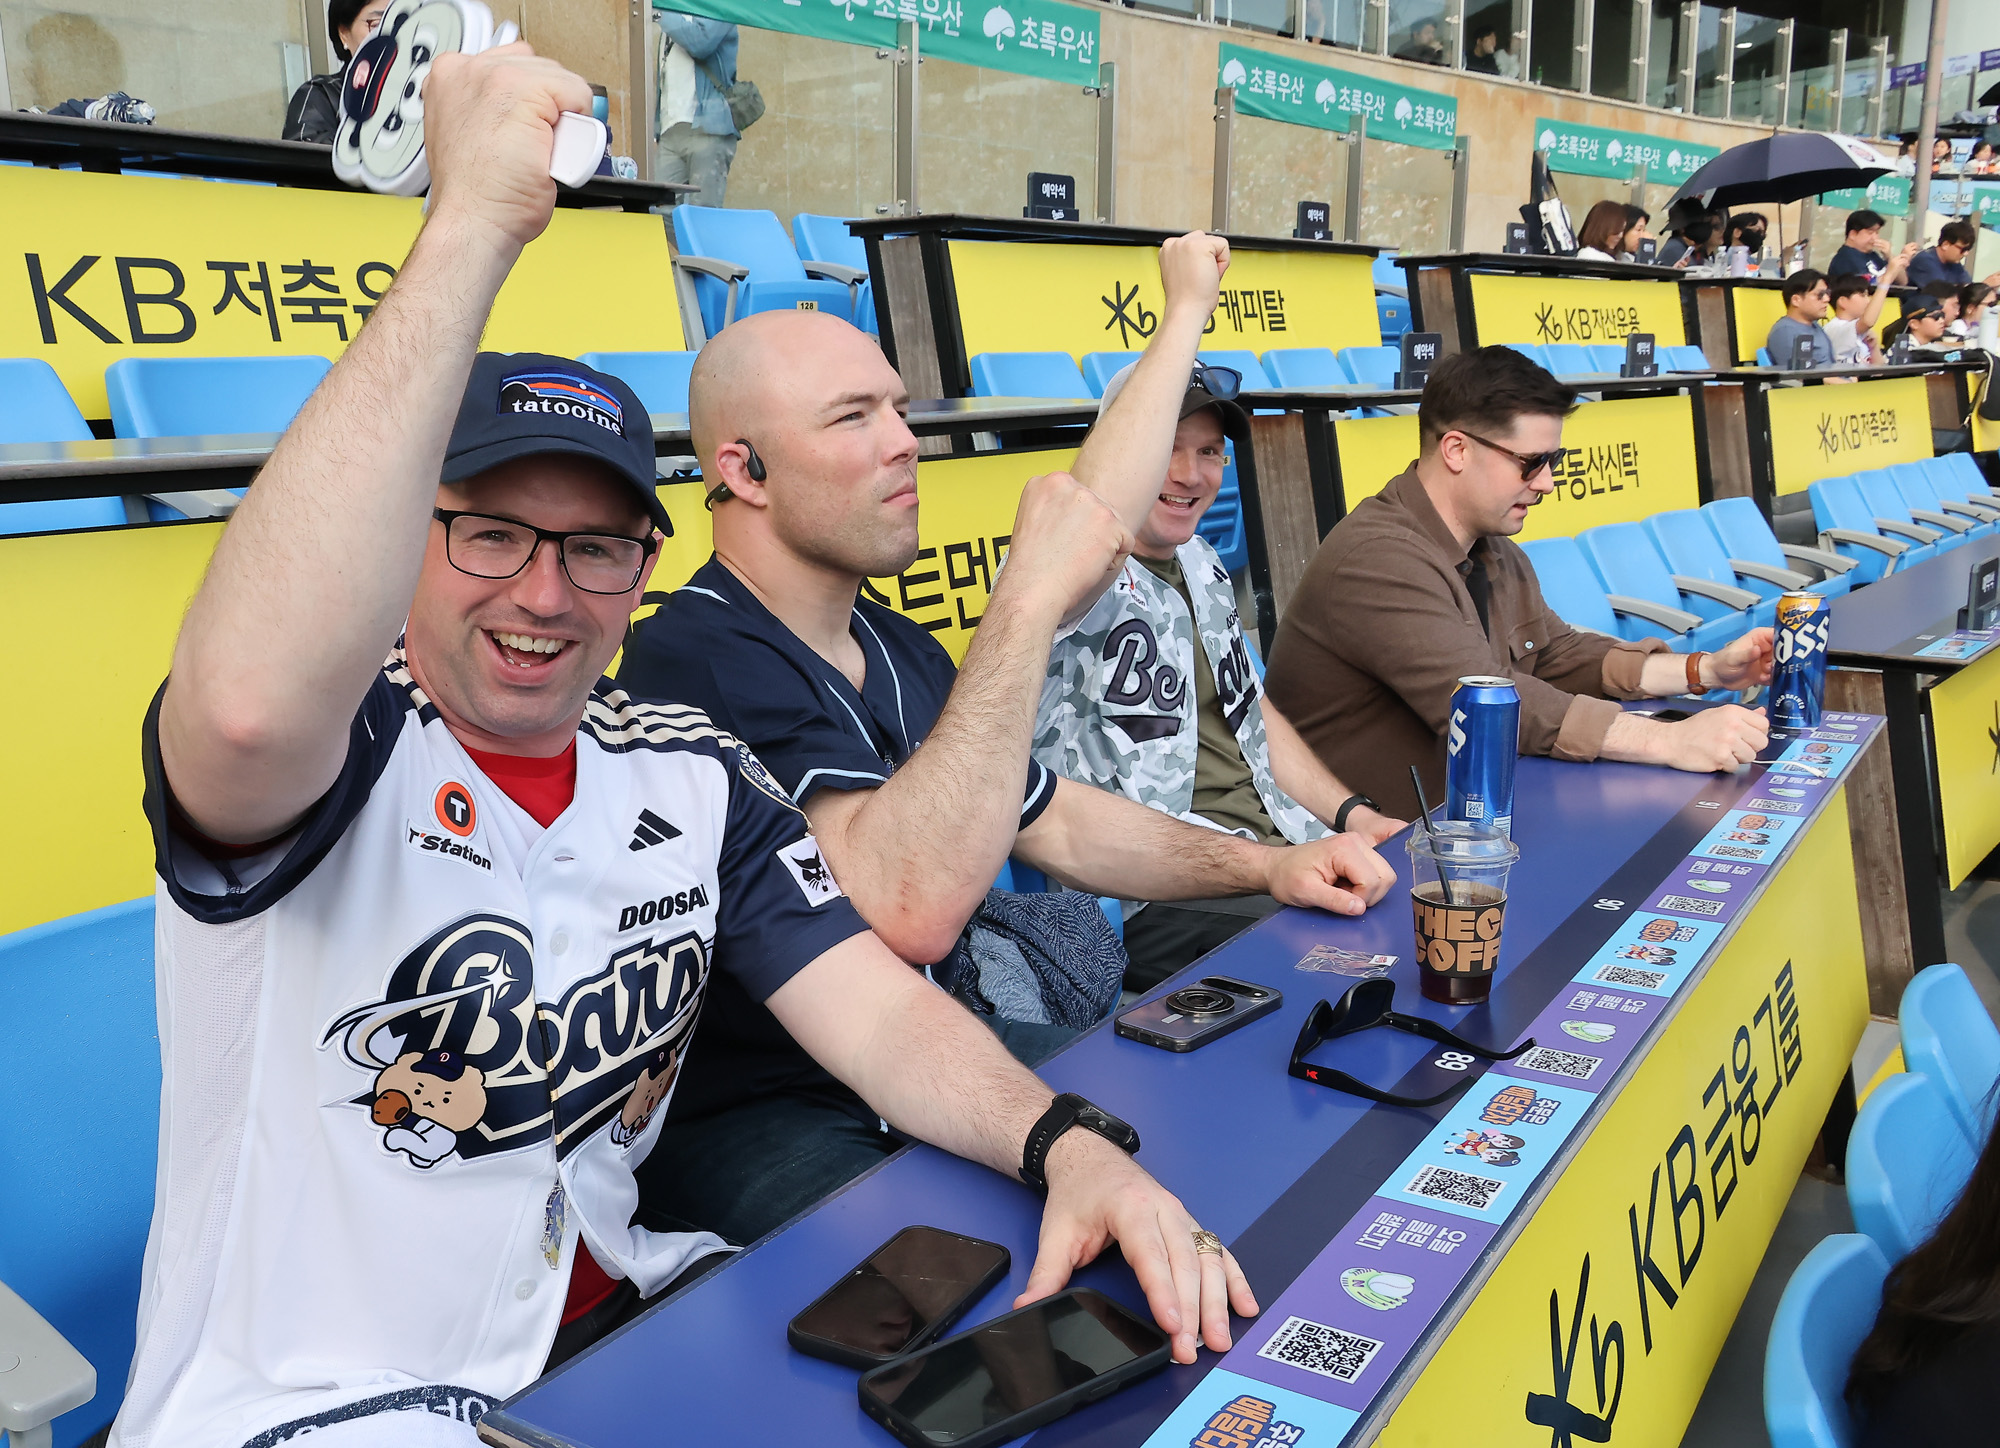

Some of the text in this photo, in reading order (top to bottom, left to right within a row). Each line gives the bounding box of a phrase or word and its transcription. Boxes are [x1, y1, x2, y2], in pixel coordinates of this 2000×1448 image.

[1019, 16, 1095, 64] 초록우산
[1249, 66, 1305, 105] 초록우산
[1338, 84, 1386, 122] 초록우산
[1414, 103, 1455, 137] 초록우산
[1558, 134, 1600, 161] 초록우산
[1623, 144, 1661, 169] 초록우산
[1041, 182, 1066, 200] 예약석
[800, 302, 814, 310] 128
[1413, 342, 1436, 361] 예약석
[512, 398, 622, 436] tatooine
[1774, 615, 1830, 665] ass
[449, 795, 469, 824] T
[1480, 1086, 1537, 1126] 배달타자
[1521, 1098, 1561, 1125] 주문은
[1355, 1211, 1408, 1251] 챌린지
[1395, 1218, 1438, 1248] 클립
[1427, 1227, 1468, 1256] 오늘
